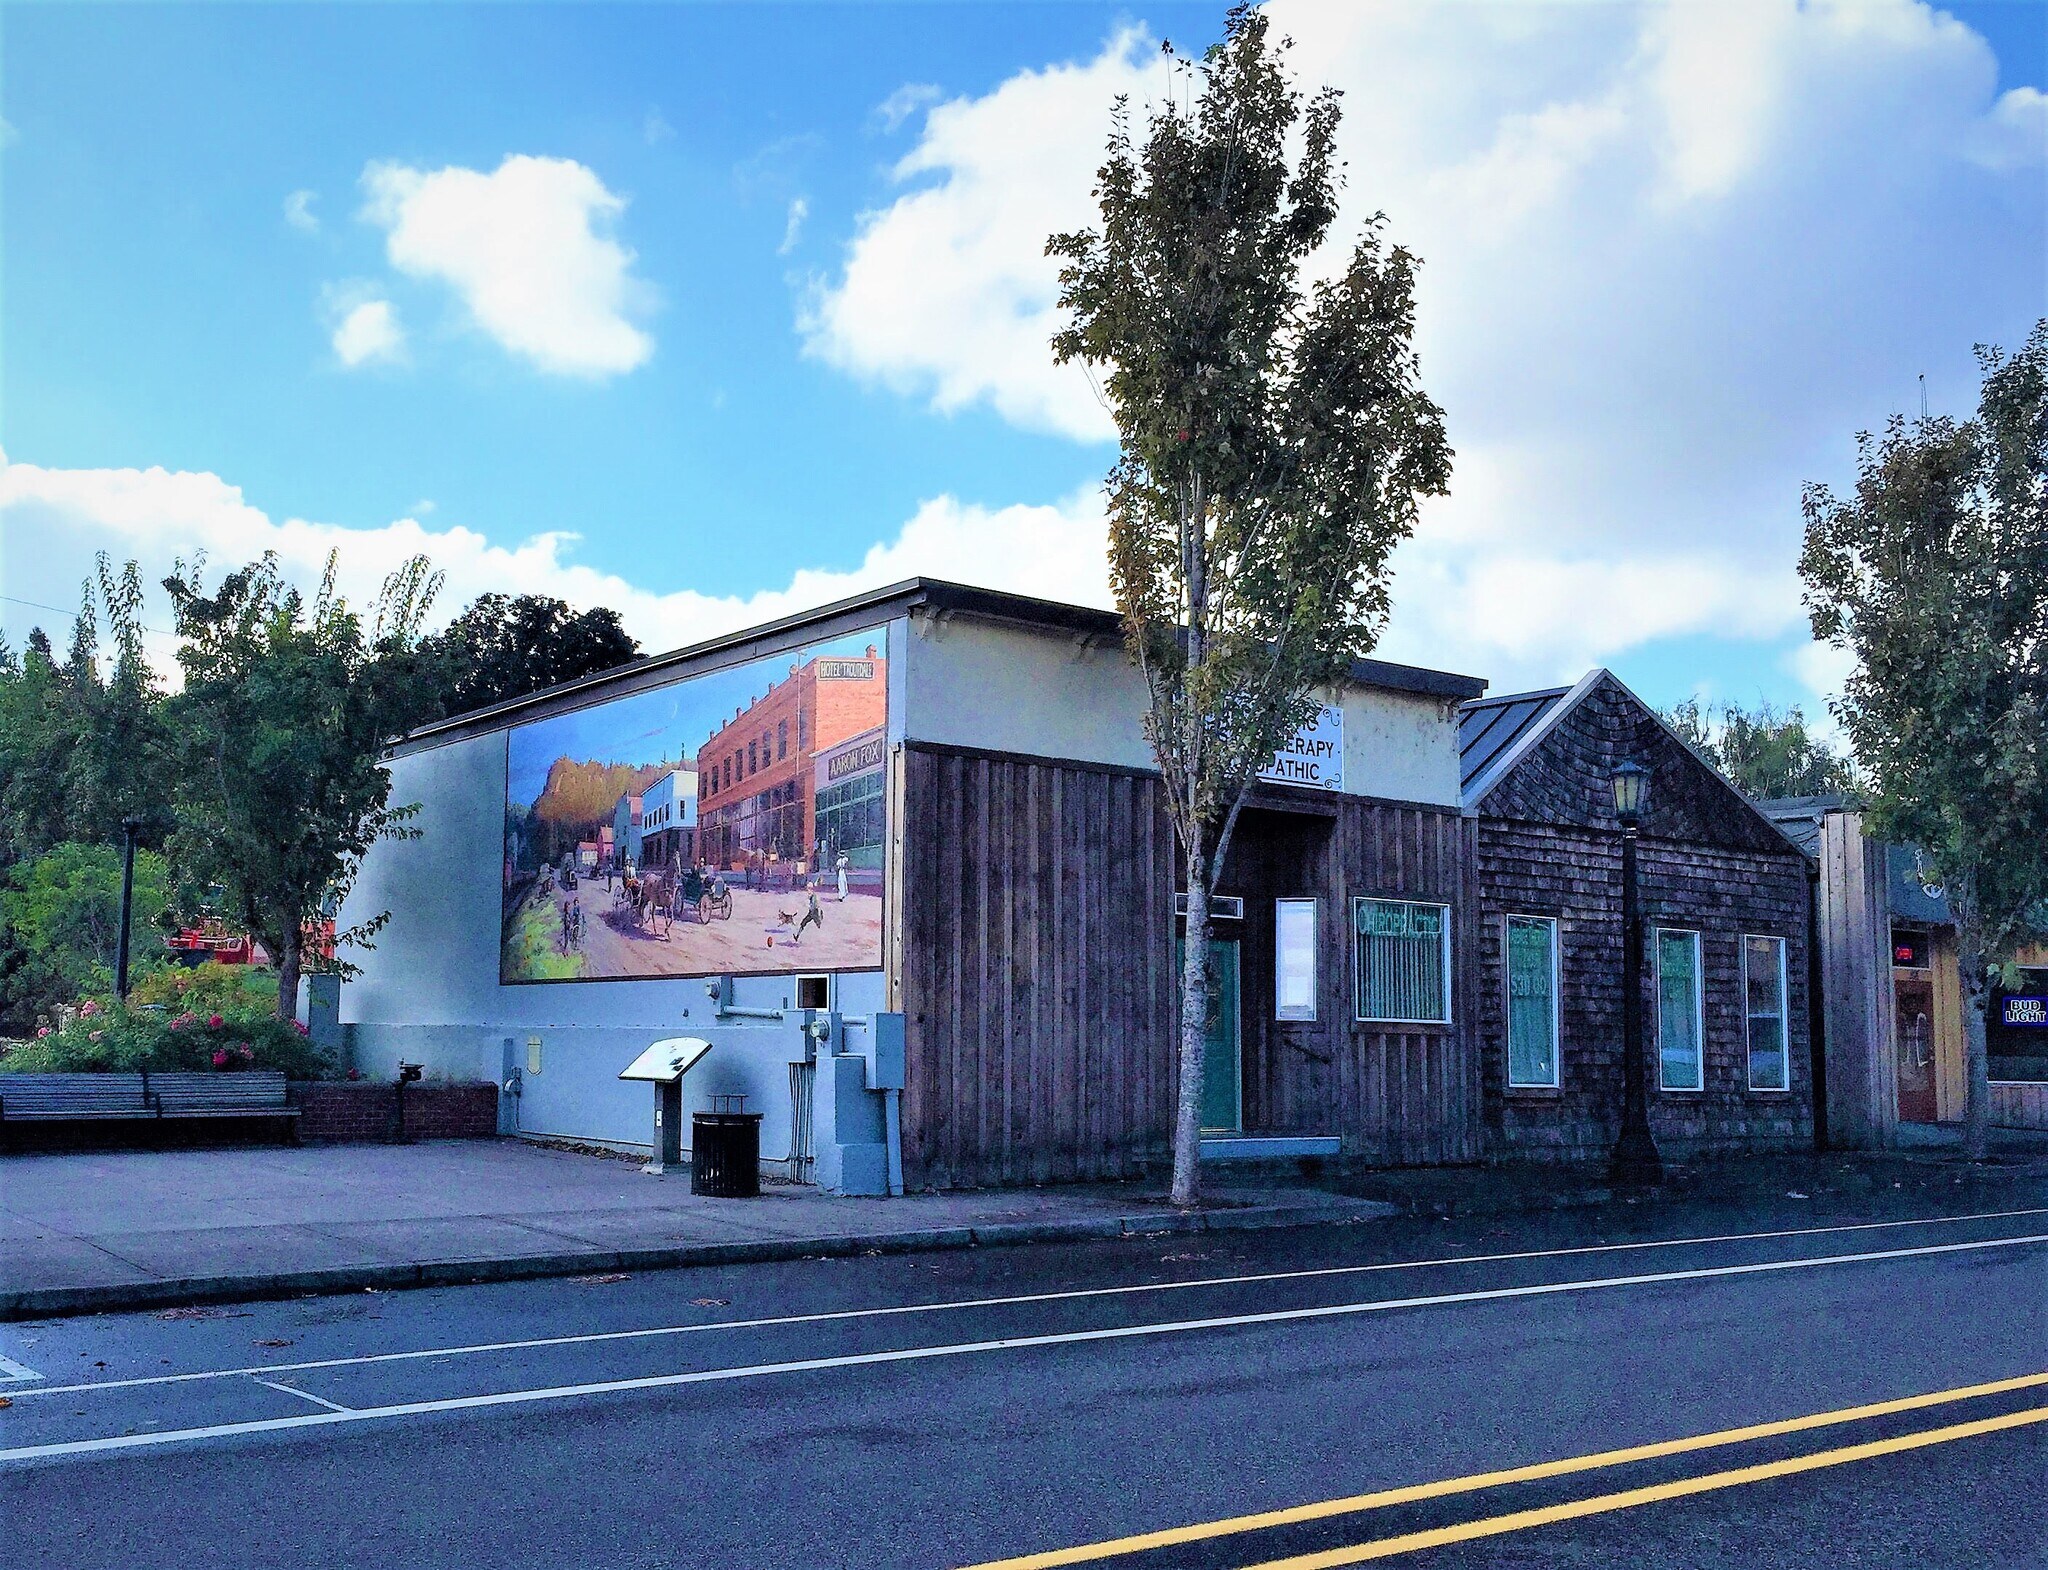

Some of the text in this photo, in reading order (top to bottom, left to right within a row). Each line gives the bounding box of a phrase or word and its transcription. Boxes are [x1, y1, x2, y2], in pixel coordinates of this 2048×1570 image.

[820, 661, 841, 677] HOTEL
[1276, 734, 1334, 758] ERAPY
[830, 740, 880, 776] AARON FOX
[1255, 758, 1320, 781] OPATHIC
[2010, 999, 2041, 1011] BUD
[2005, 1010, 2047, 1023] LIGHT
